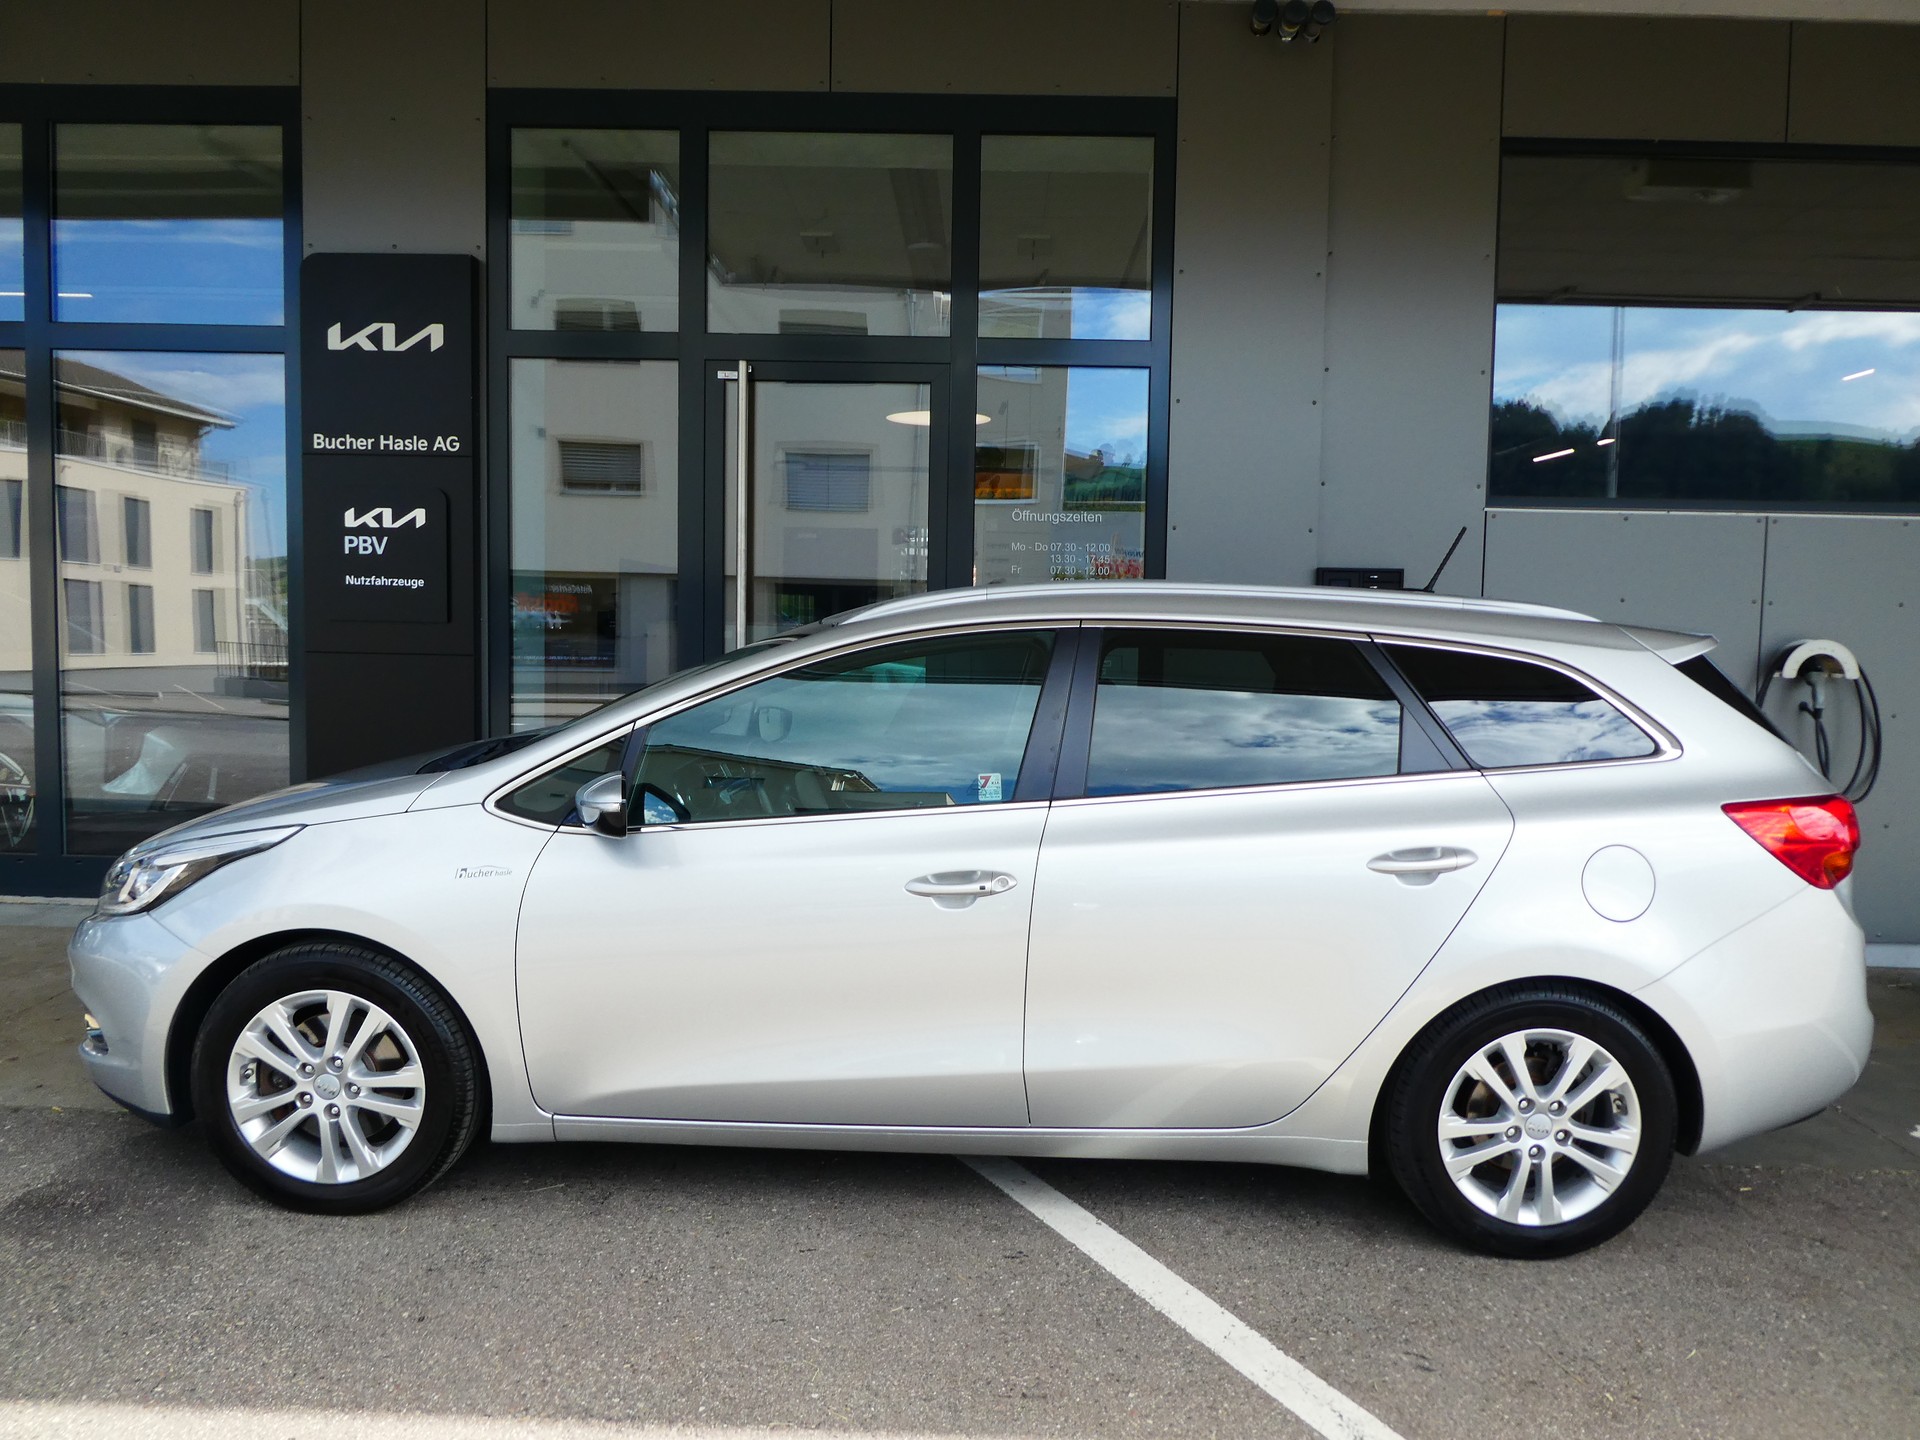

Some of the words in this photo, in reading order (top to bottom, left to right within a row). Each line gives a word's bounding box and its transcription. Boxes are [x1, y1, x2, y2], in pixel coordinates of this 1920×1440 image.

[313, 433, 375, 451] Bucher
[379, 434, 428, 451] Hasle
[433, 435, 460, 452] AG
[1011, 508, 1102, 524] Öffnungszeiten
[344, 535, 388, 555] PBV
[1011, 542, 1026, 551] Mo
[1034, 542, 1048, 551] Do
[1050, 542, 1076, 552] 07.30
[1085, 543, 1111, 552] 12.00
[1050, 554, 1076, 564] 13.30
[1085, 555, 1110, 564] 17.45
[1011, 565, 1021, 574] Fr
[1050, 566, 1076, 575] 07.30
[1085, 567, 1110, 576] 12.00
[345, 575, 425, 588] Nutzfahrzeuge
